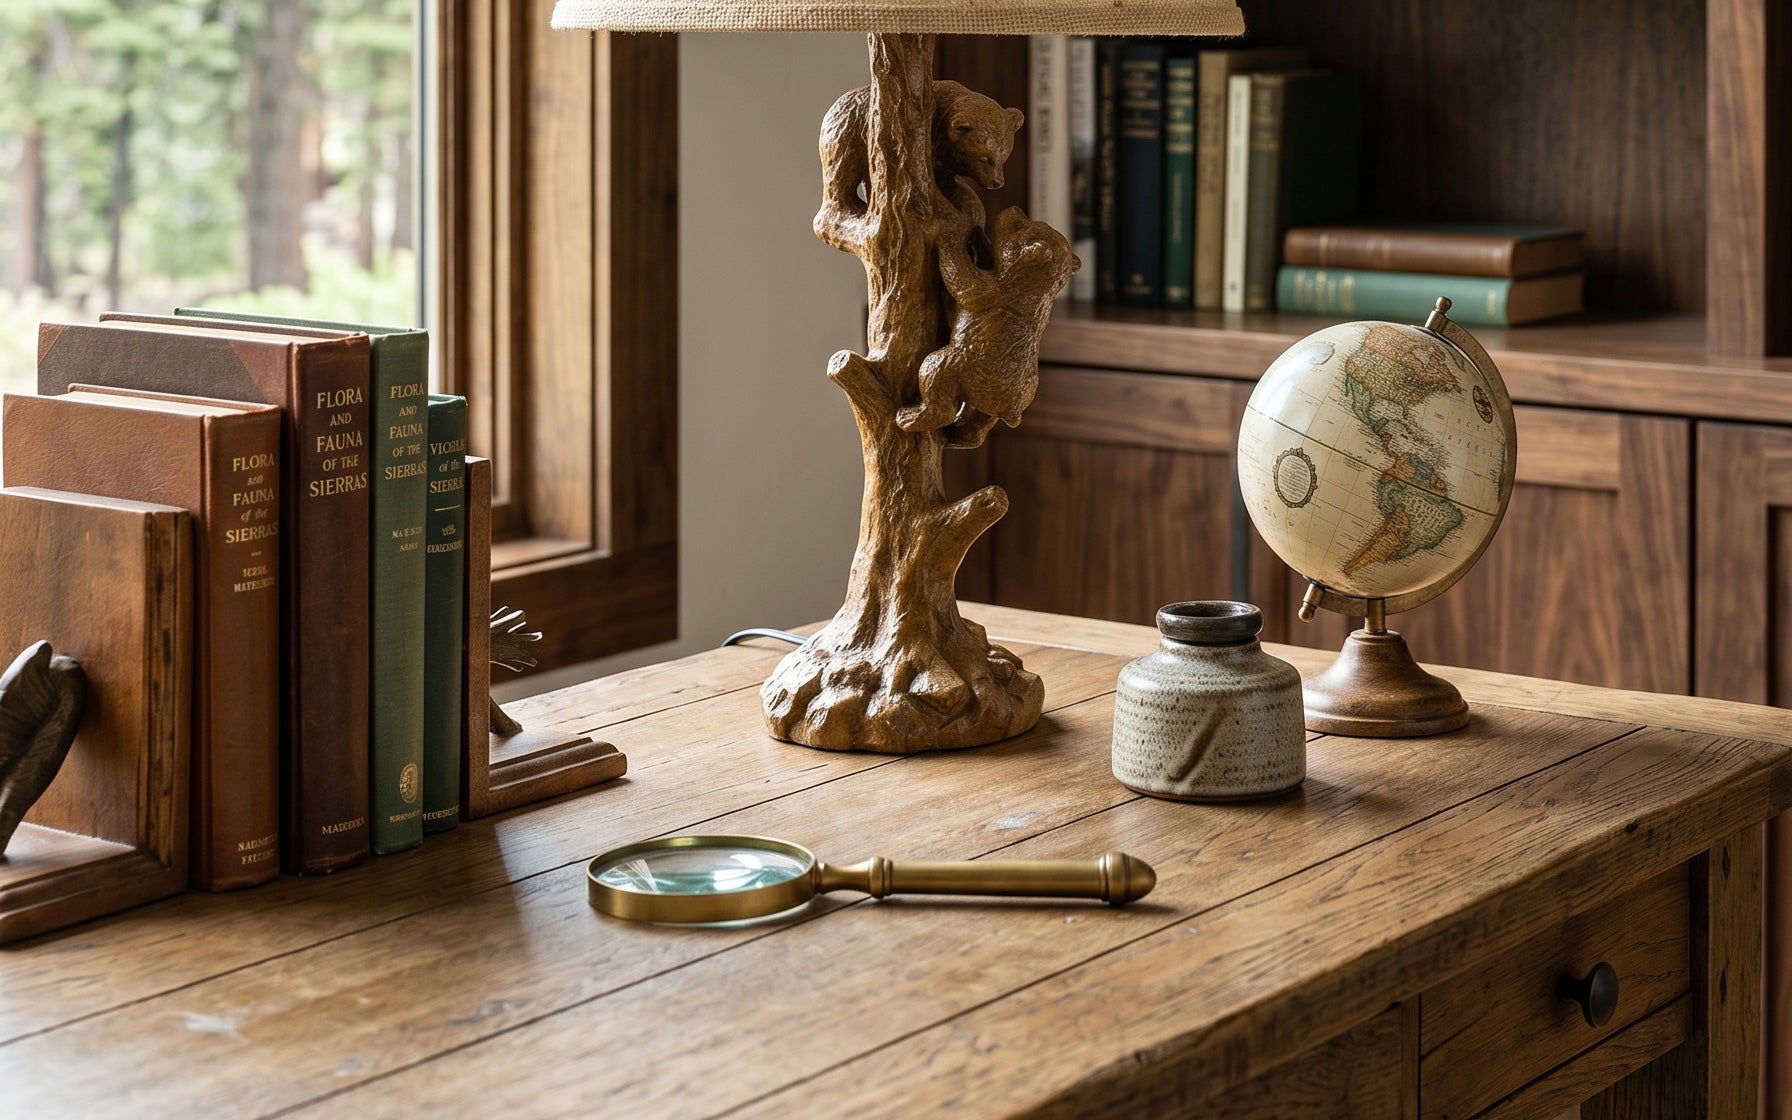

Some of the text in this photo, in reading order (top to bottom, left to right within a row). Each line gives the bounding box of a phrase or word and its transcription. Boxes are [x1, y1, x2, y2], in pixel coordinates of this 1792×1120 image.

[316, 387, 363, 410] FLORA
[391, 383, 424, 399] FLORA
[330, 412, 352, 426] AND
[389, 423, 423, 439] FAUNA
[316, 430, 363, 453] FAUNA
[232, 452, 275, 472] FLORA
[392, 447, 404, 458] OF
[322, 454, 359, 472] OF THE
[384, 460, 427, 480] SIERRAS
[309, 472, 368, 498] SIERRAS
[232, 487, 275, 507] FAUNA
[225, 521, 279, 544] SIERRAS
